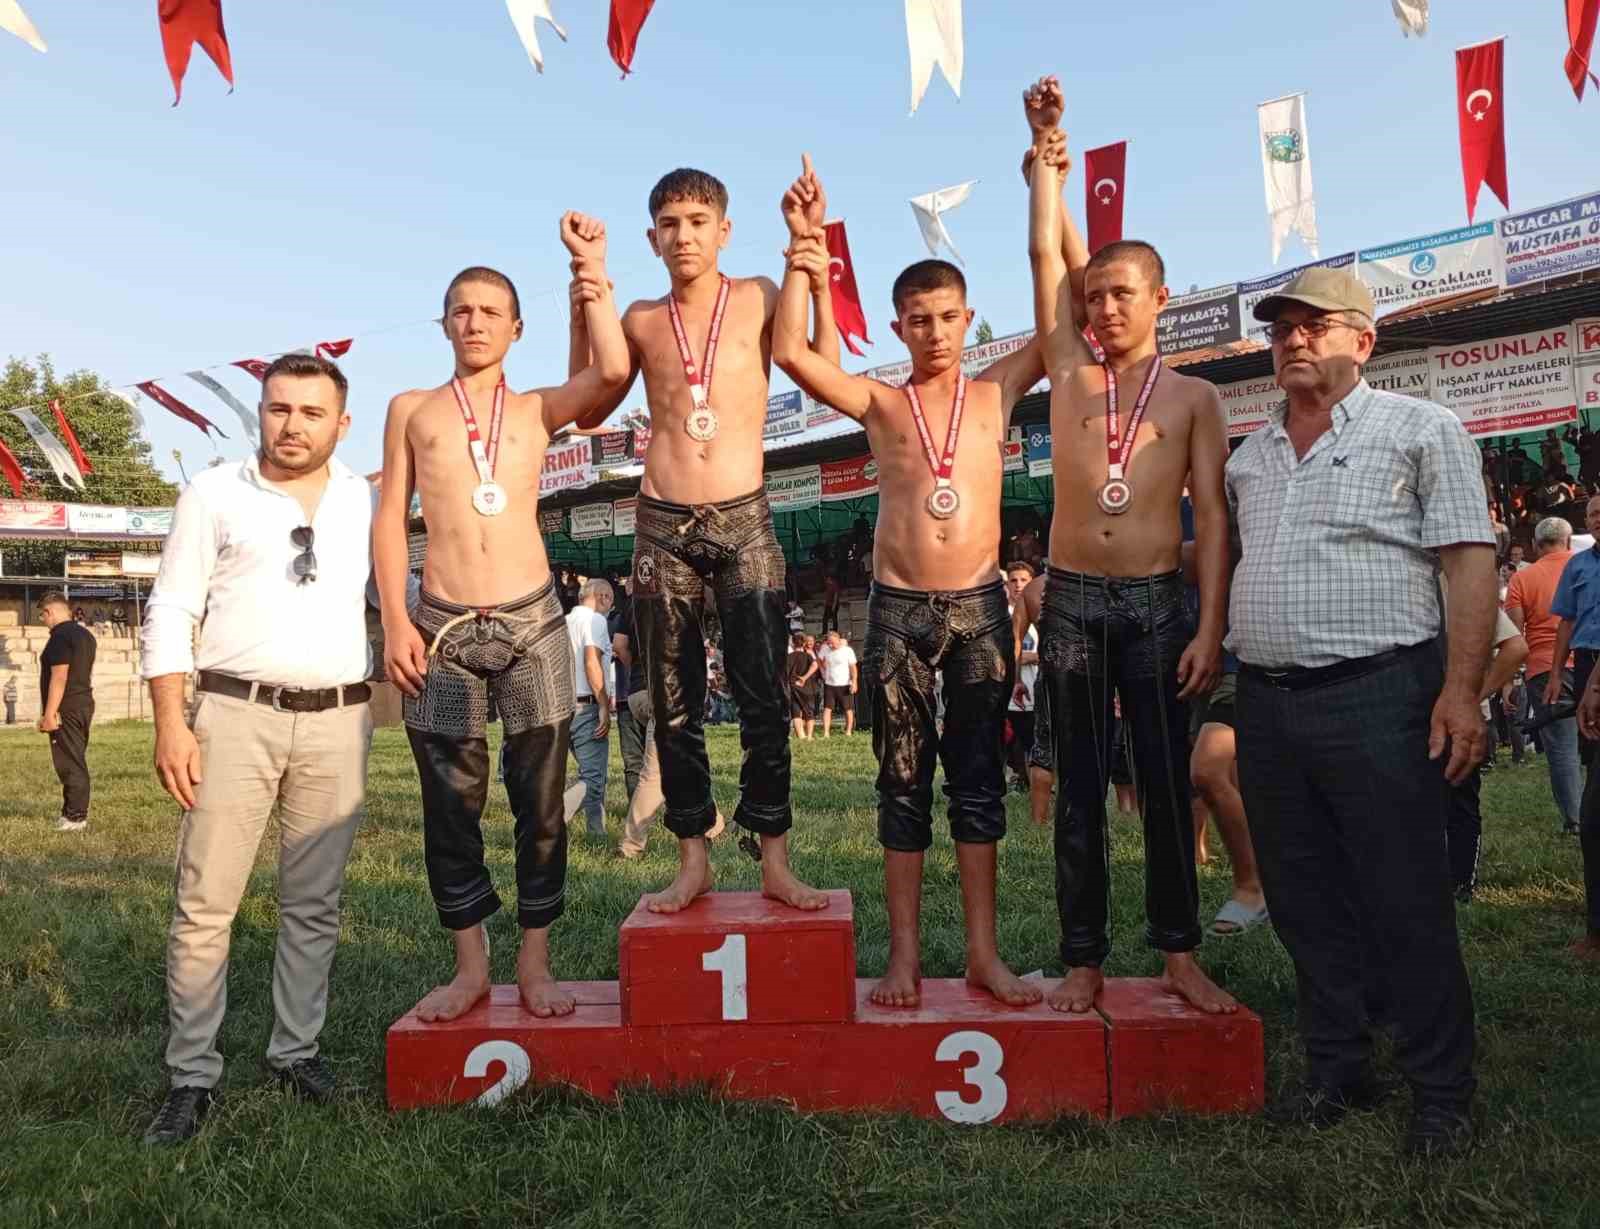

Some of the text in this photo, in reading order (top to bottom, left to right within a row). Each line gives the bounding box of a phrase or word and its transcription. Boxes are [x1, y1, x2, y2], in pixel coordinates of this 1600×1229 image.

[1504, 208, 1572, 235] ÖZACAR
[1506, 226, 1581, 255] MUSTAFA
[1180, 303, 1229, 324] KARATAŞ
[1179, 335, 1215, 350] BAŞKANI
[1434, 331, 1569, 371] TOSUNLAR
[1436, 372, 1481, 389] İNŞAAT
[1484, 355, 1571, 381] MALZEMELERİ
[1446, 381, 1505, 399] FORKLİFT
[1508, 372, 1562, 390] NAKLİYE
[702, 934, 748, 1021] 1
[462, 1039, 532, 1108] 2
[934, 1030, 1008, 1125] 3
